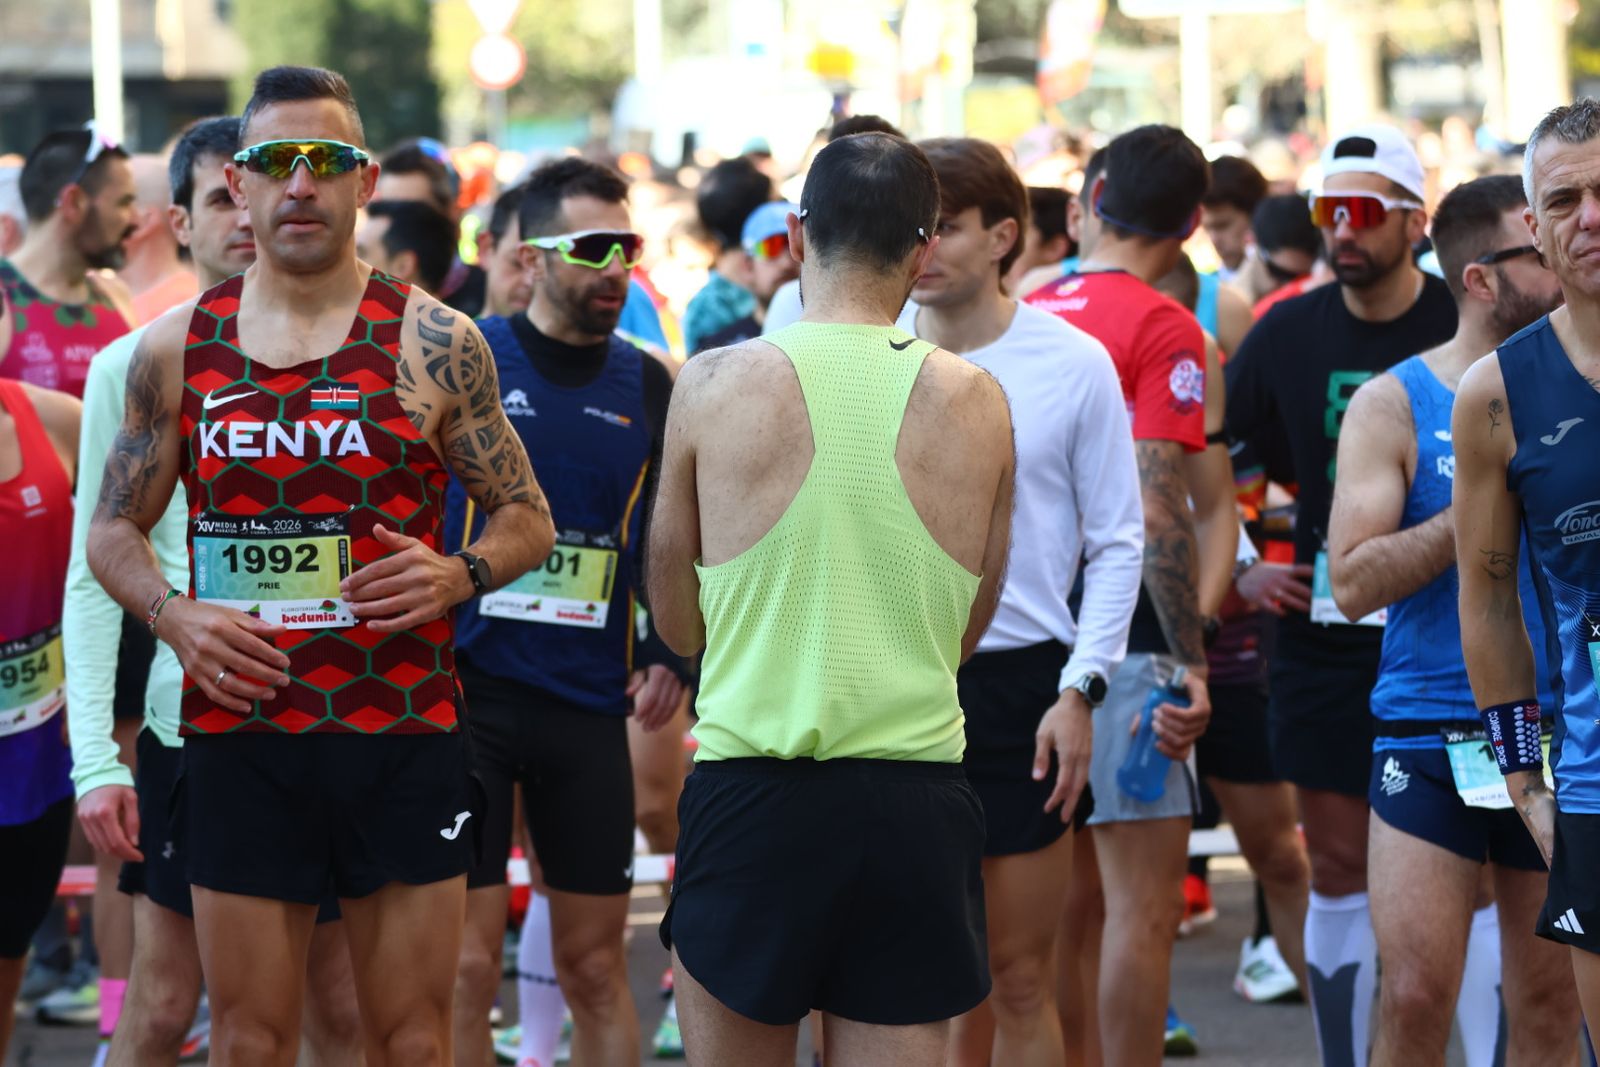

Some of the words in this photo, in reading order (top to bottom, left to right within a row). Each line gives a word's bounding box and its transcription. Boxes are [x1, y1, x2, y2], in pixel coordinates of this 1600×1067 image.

[199, 420, 371, 459] KENYA
[273, 519, 302, 531] 2026
[222, 543, 319, 573] 1992
[531, 549, 581, 577] 01
[257, 581, 280, 590] PRIE
[281, 612, 337, 624] bedunia
[0, 650, 50, 689] 954
